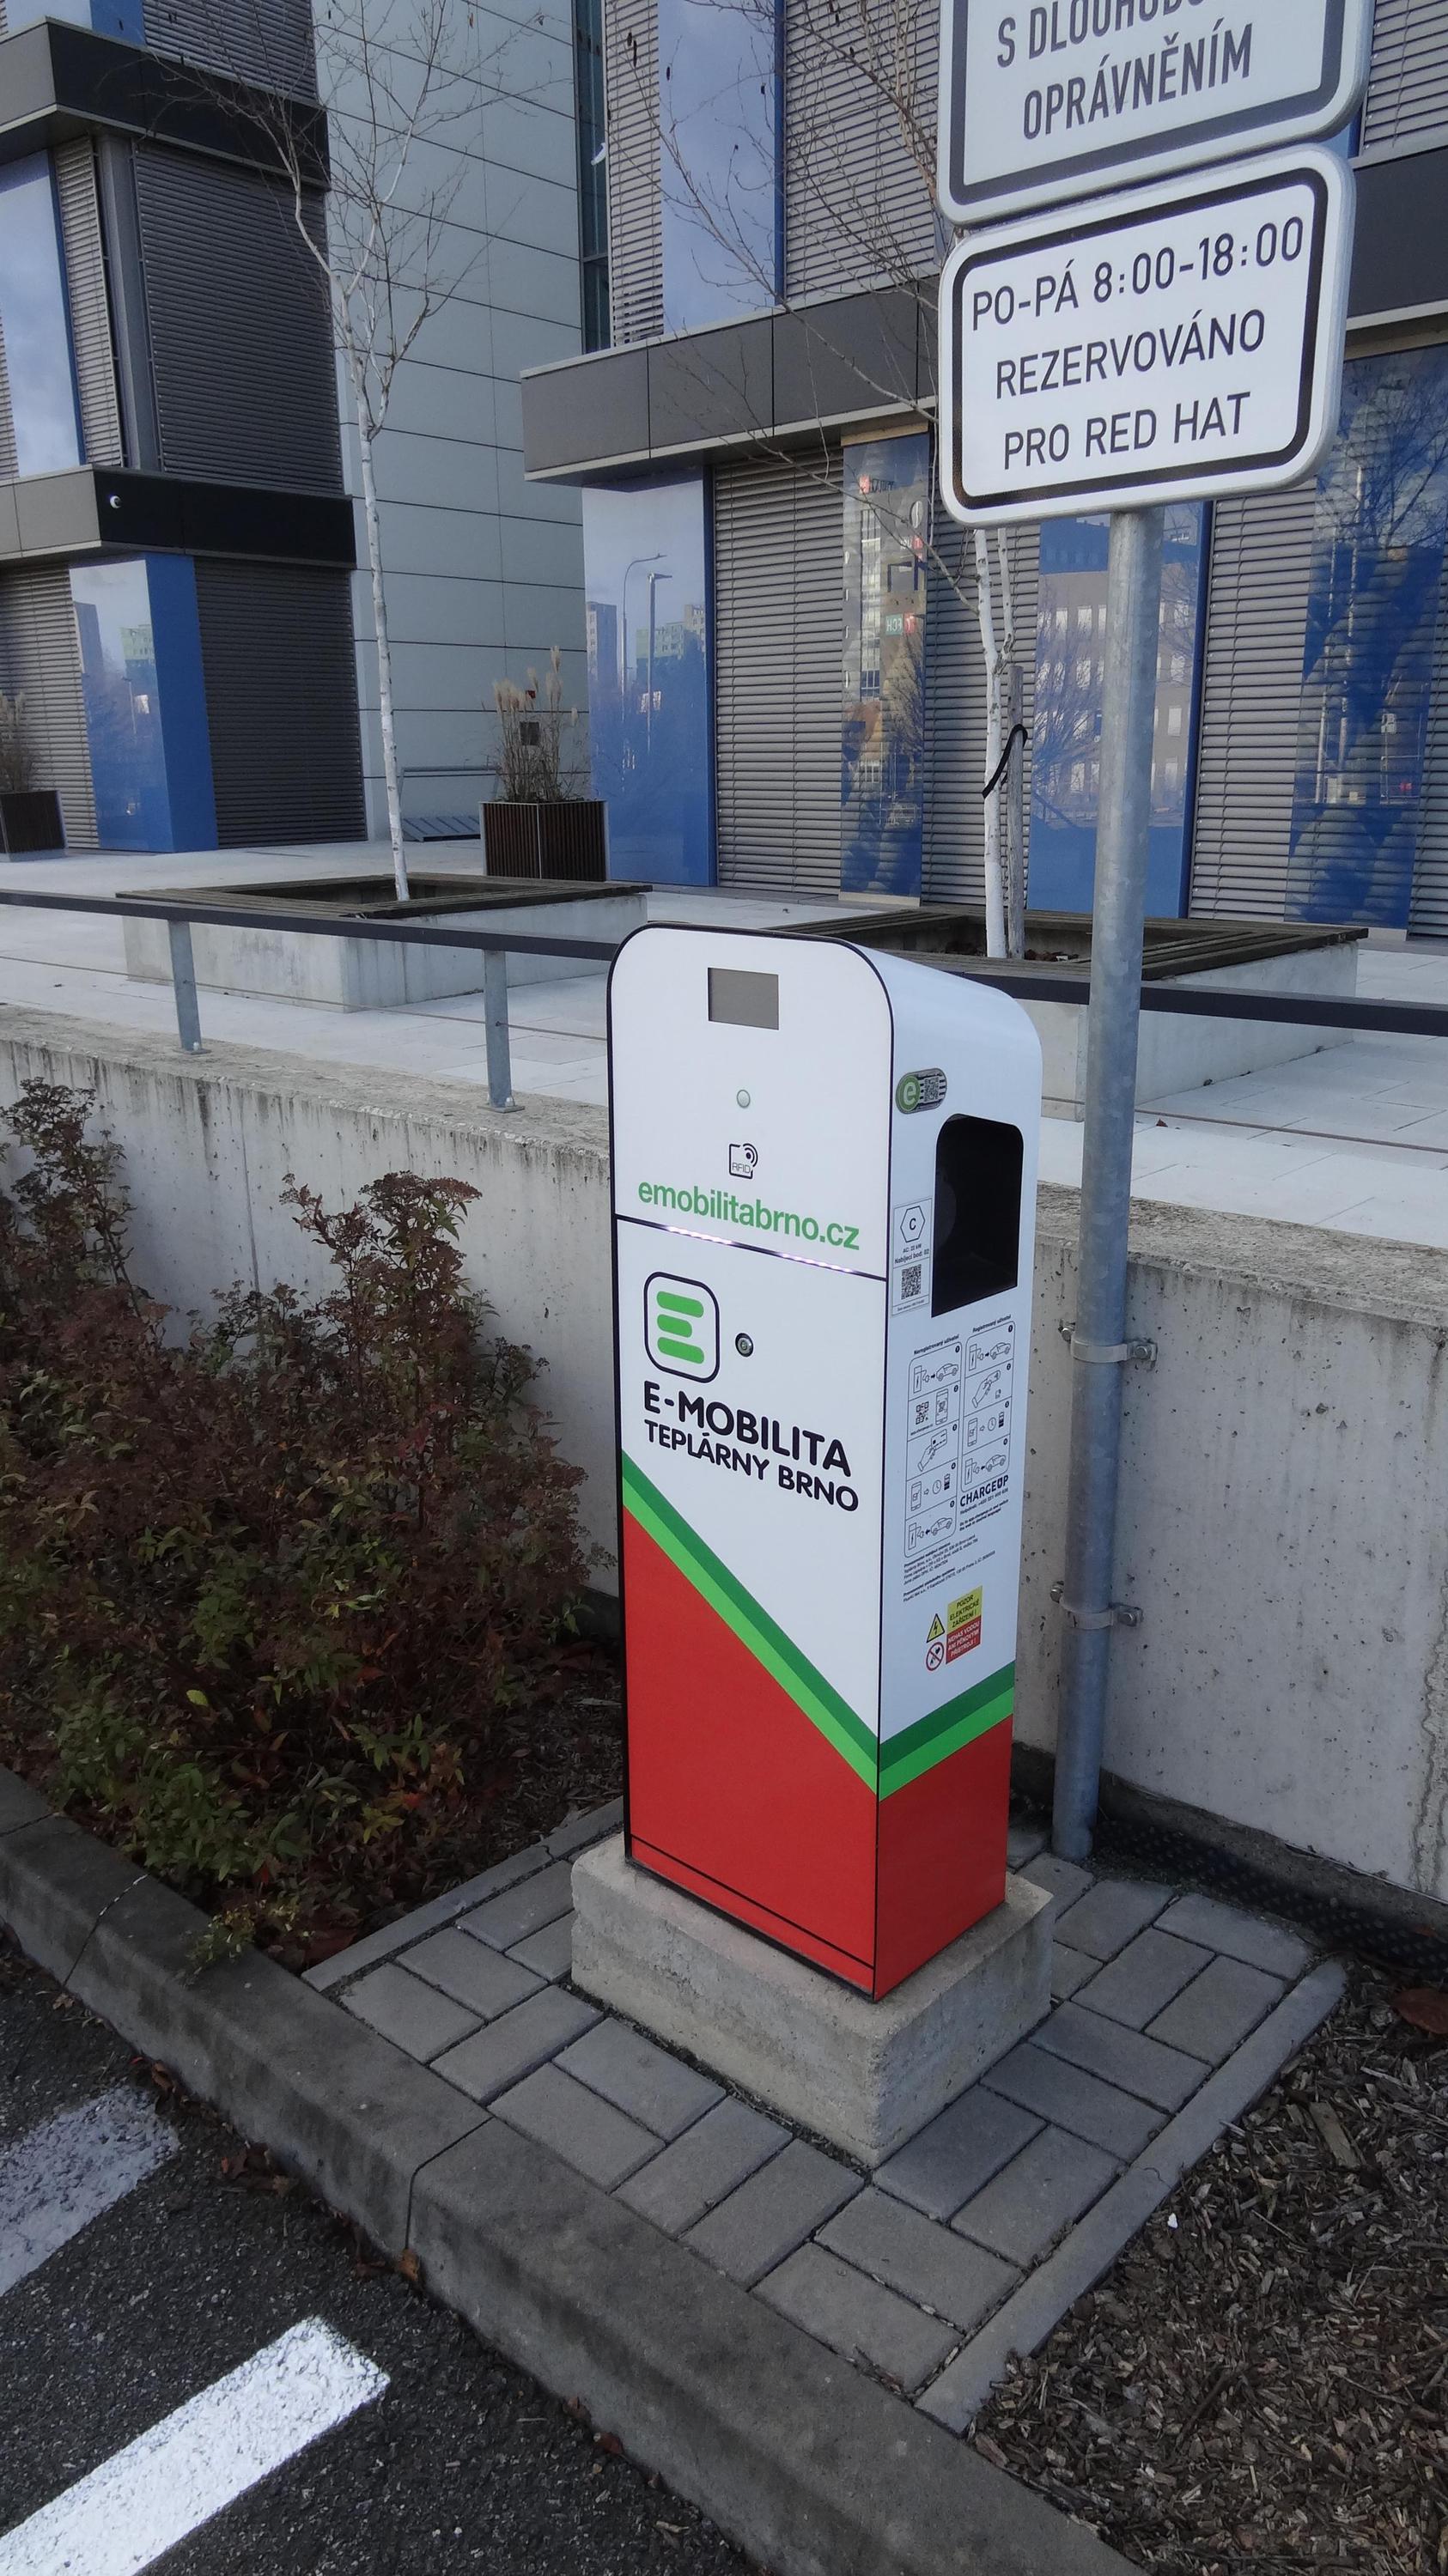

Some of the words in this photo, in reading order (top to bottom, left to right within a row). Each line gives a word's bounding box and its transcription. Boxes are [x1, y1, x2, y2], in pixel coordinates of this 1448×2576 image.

[996, 17, 1016, 68] S
[1023, 17, 1254, 140] OPRÁVNĚNÍM
[972, 259, 1079, 331] PO-PÁ
[1093, 216, 1304, 304] 8:00-18:00
[996, 308, 1266, 400] REZERVOVÁNO
[1004, 422, 1069, 470] PRO
[1085, 408, 1157, 457] RED
[1173, 391, 1250, 444] HAT
[732, 1162, 751, 1174] RFID
[638, 1181, 860, 1251] emobilitabrno.cz
[909, 1217, 917, 1231] C
[643, 1379, 852, 1478] E-MOBILITA
[643, 1419, 770, 1481] TEPLÁRNY
[778, 1464, 860, 1512] BRNO
[959, 1474, 1009, 1507] CHARGEUP
